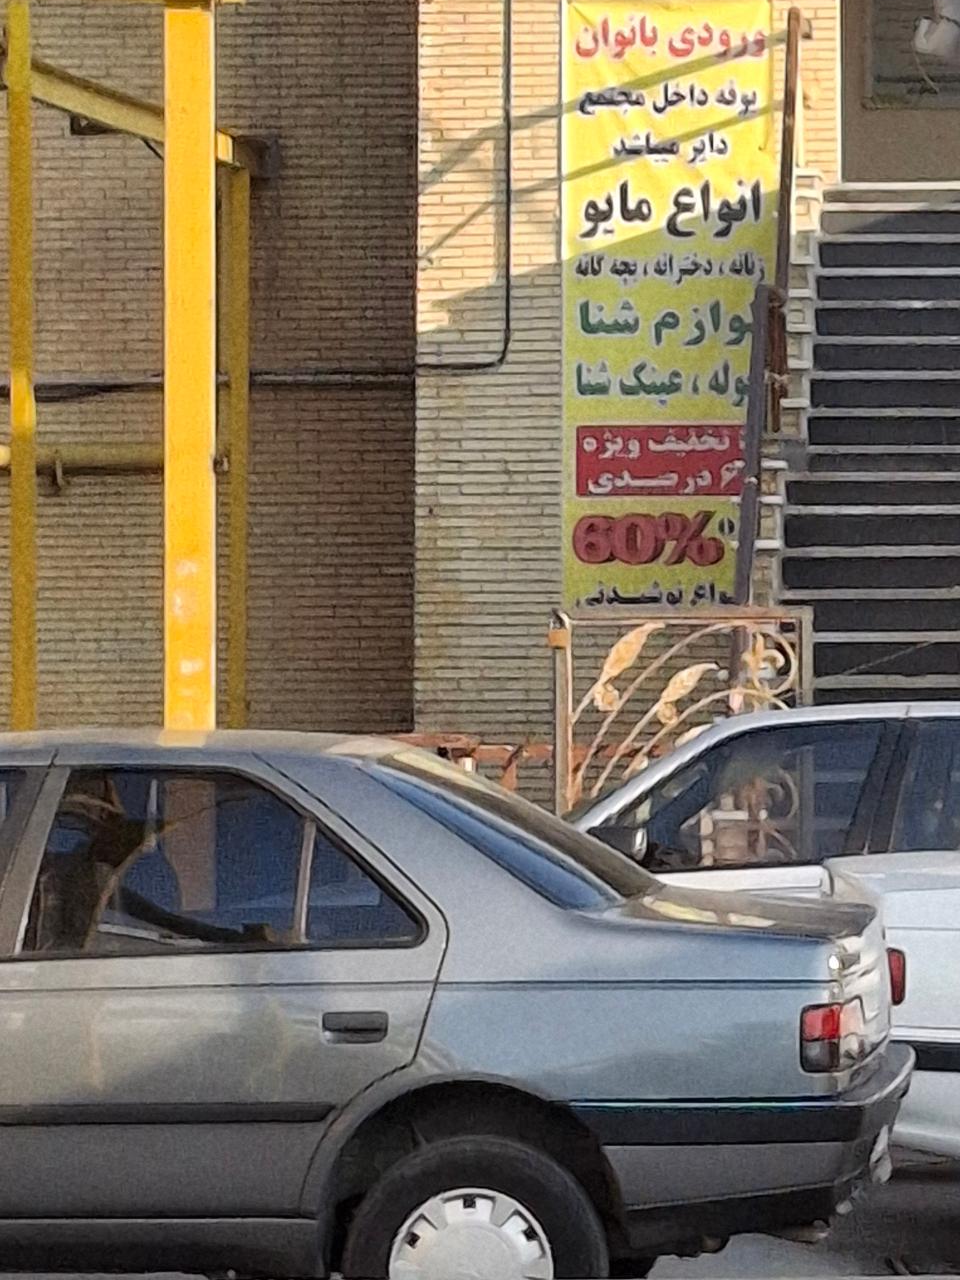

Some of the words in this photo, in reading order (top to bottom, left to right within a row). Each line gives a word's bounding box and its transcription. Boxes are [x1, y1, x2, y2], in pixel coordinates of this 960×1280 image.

[575, 15, 658, 60] بانوان
[668, 22, 767, 58] ورودی
[578, 86, 647, 116] مجتمع
[652, 82, 709, 114] داخل
[716, 80, 758, 116] بوفه
[688, 131, 729, 164] دایر
[579, 180, 652, 238] مایو
[666, 179, 761, 238] انواع
[579, 299, 640, 335] شنا
[654, 299, 753, 346] وازم
[576, 362, 612, 396] شنا
[619, 361, 683, 406] عینک
[582, 430, 642, 459] ویژه
[648, 428, 731, 458] تخفیف
[573, 510, 726, 567] 60%
